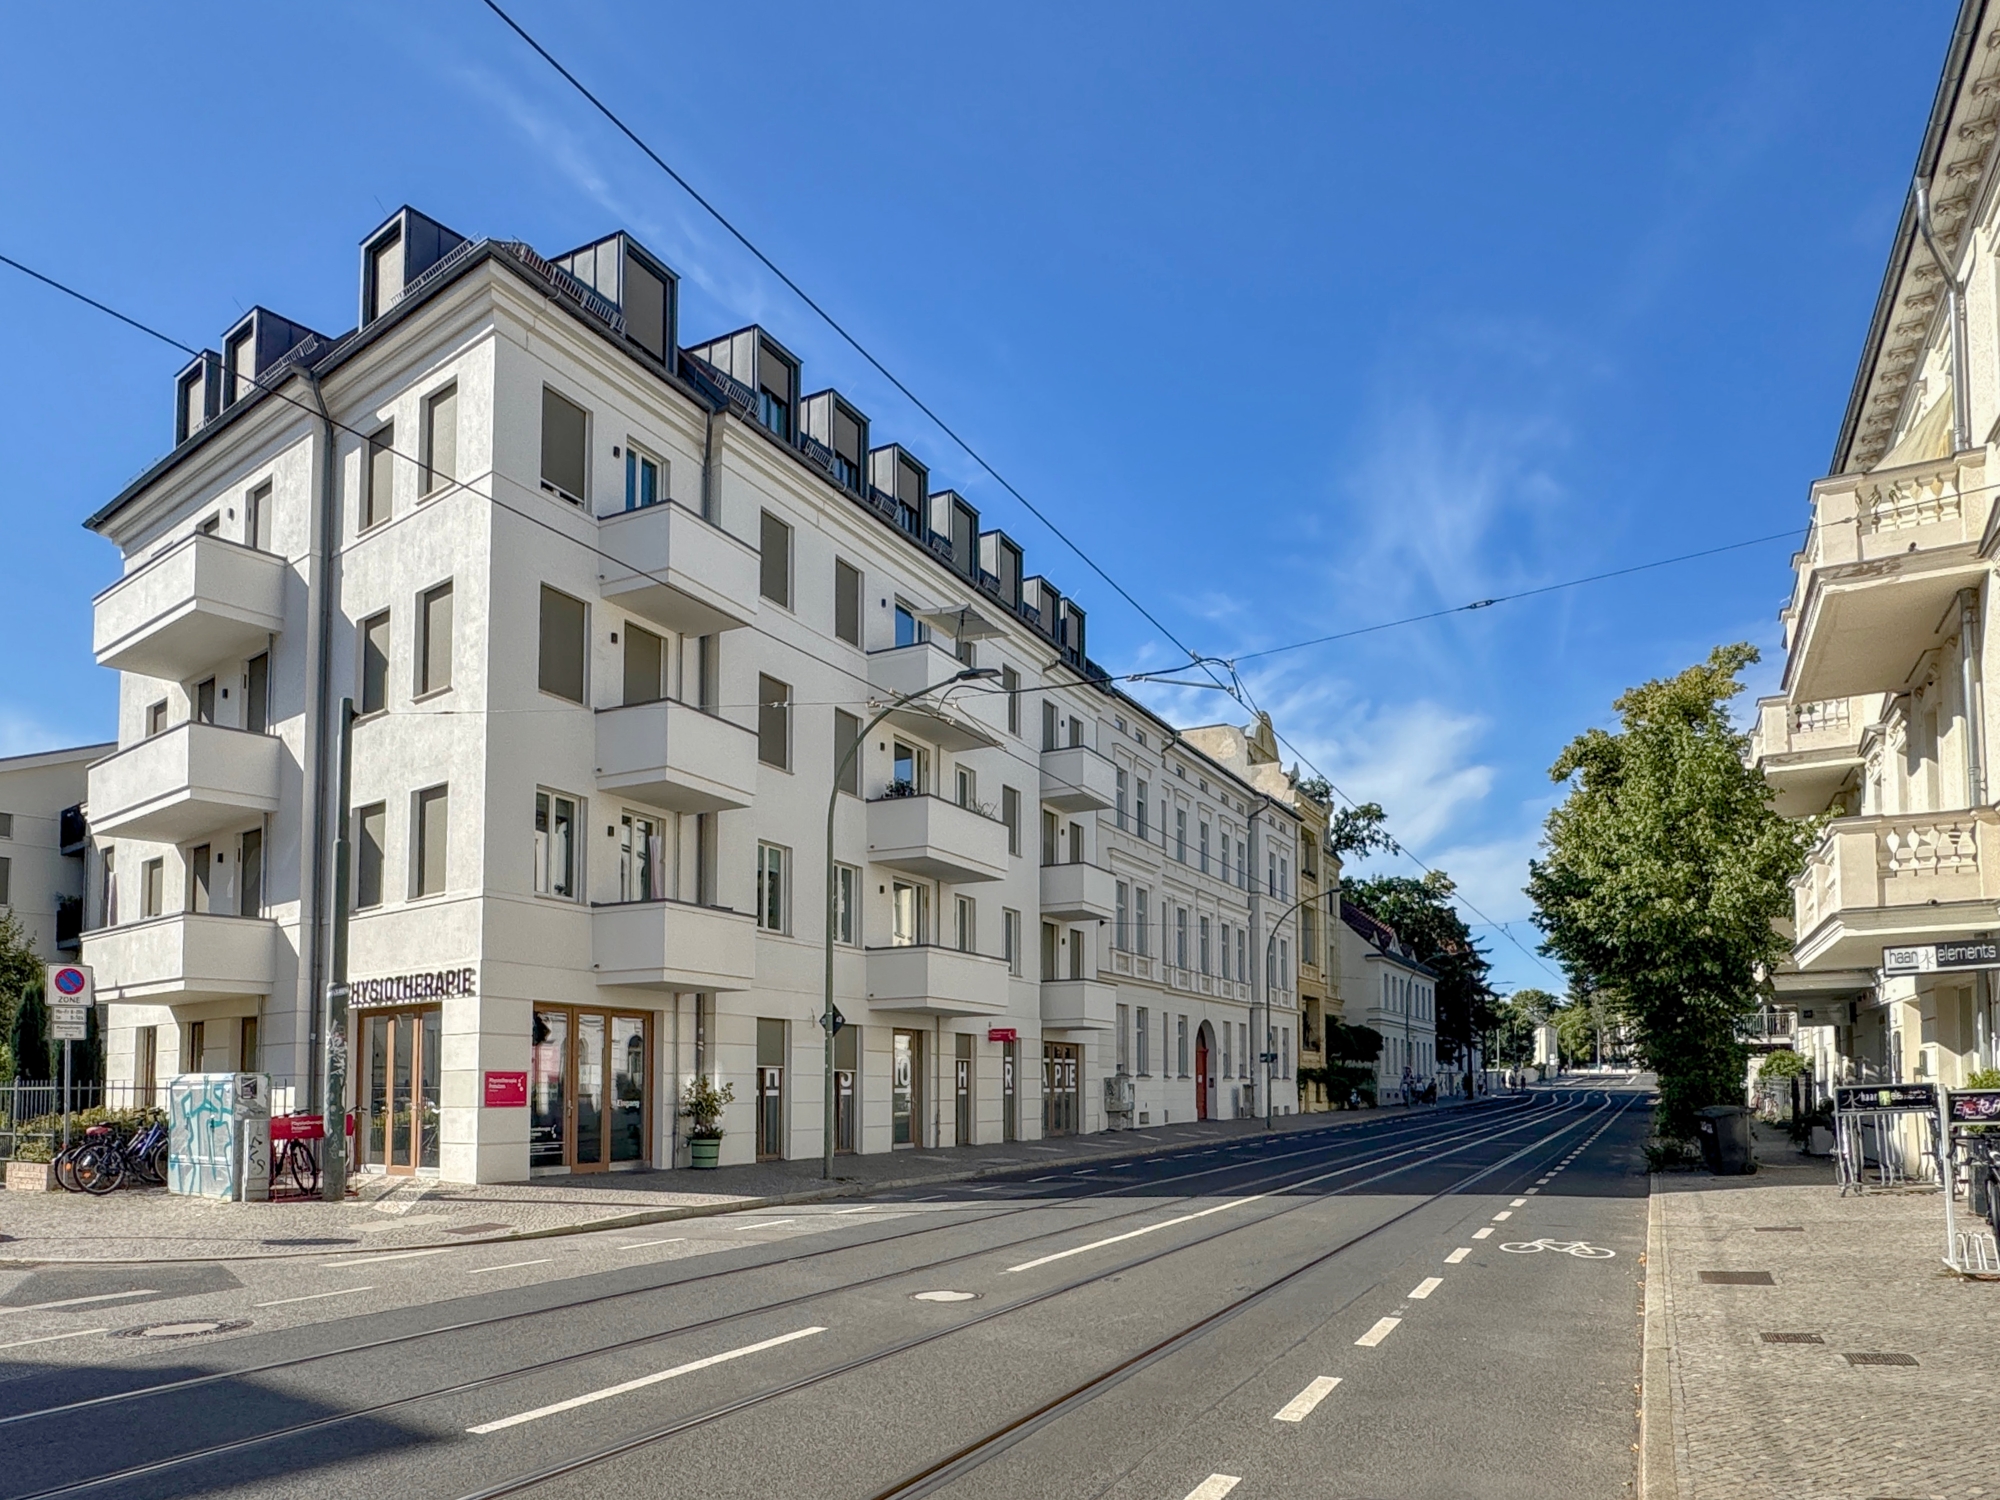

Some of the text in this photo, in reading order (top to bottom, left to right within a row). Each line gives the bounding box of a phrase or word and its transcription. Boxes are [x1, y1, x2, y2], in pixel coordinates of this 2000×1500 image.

[1937, 943, 1997, 962] elements
[347, 967, 474, 1005] HYSIOTHERAPIE
[57, 996, 81, 1004] ZONE
